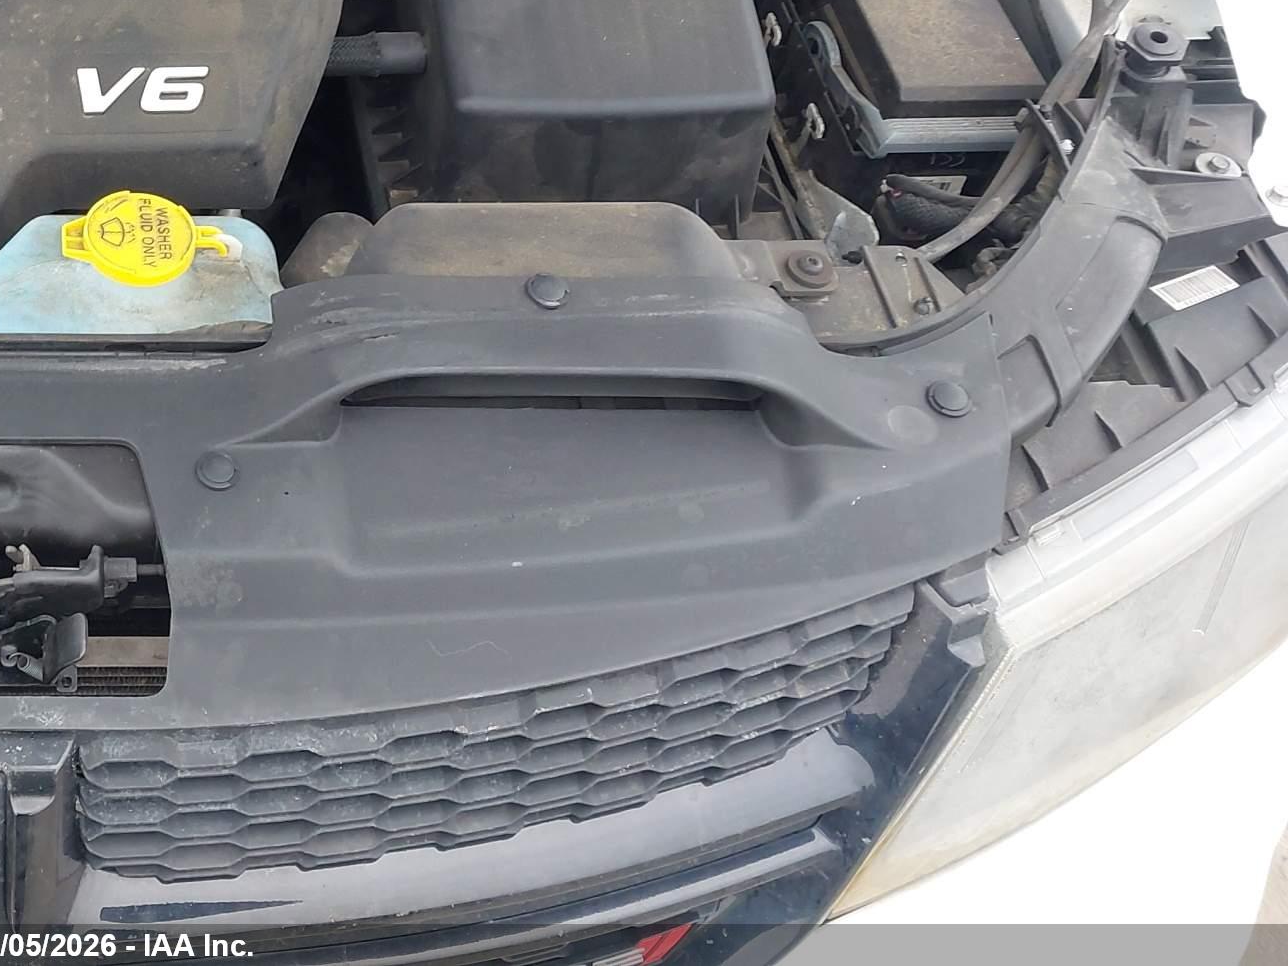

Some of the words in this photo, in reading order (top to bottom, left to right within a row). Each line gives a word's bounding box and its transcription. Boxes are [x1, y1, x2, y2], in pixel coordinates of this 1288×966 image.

[76, 66, 210, 115] V6
[137, 198, 153, 232] FLUID
[156, 207, 172, 260] WASHER
[141, 236, 157, 268] ONLY
